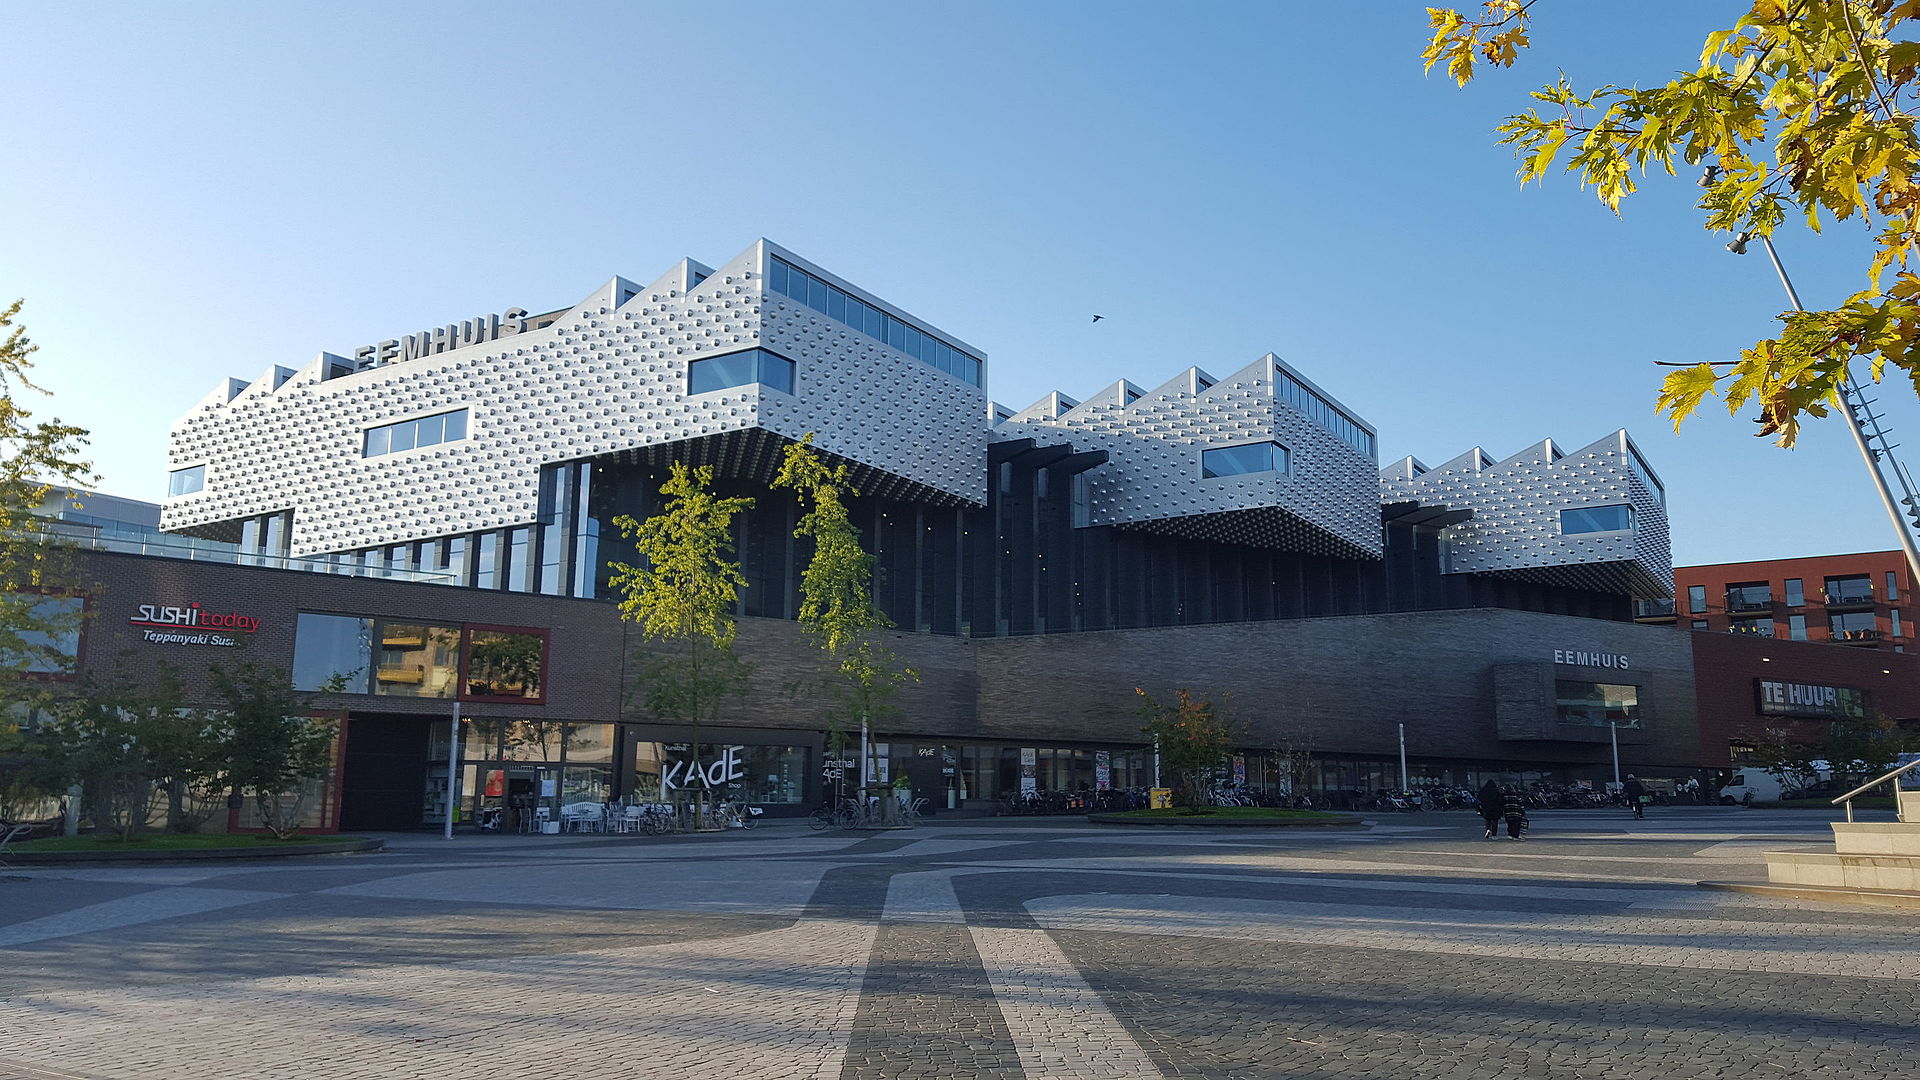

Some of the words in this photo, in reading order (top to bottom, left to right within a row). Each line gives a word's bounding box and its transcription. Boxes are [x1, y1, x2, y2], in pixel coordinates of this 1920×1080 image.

[352, 306, 528, 374] EEMHUIS
[199, 609, 260, 632] today
[143, 629, 208, 646] Teppanyaki
[1554, 649, 1629, 670] EEMHUIS
[1761, 681, 1784, 703] TE
[1788, 683, 1837, 707] HUUR
